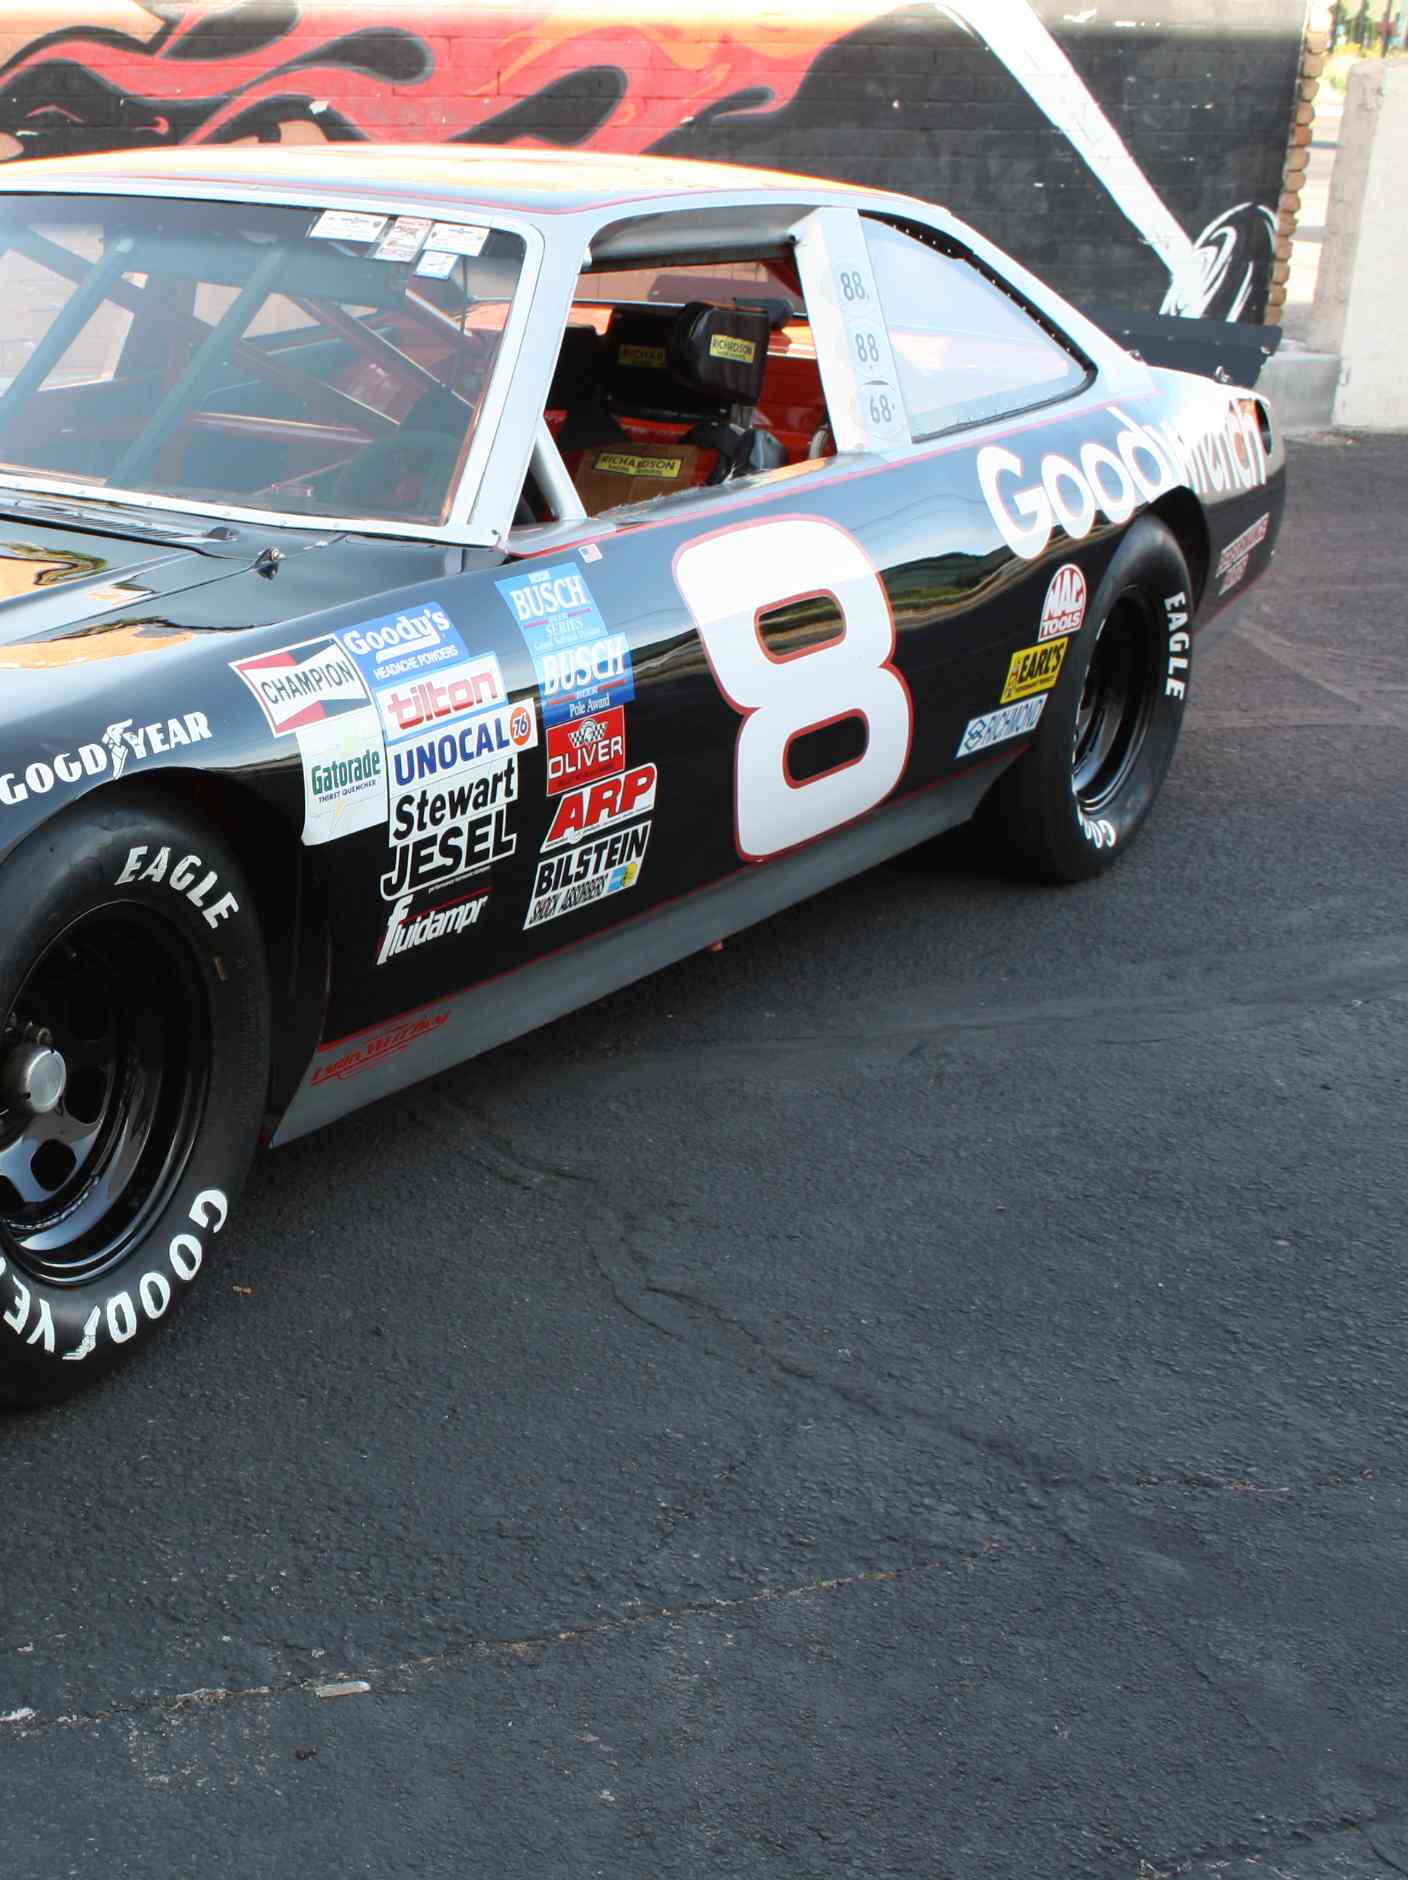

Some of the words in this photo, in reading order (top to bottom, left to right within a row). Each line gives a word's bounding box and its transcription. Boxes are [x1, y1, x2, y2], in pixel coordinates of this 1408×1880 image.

[509, 575, 589, 621] BUSCH
[1041, 612, 1082, 636] TOOLS
[343, 608, 450, 655] Goody's
[373, 656, 419, 680] HEADACHE
[417, 645, 459, 667] POWDERS
[1163, 591, 1191, 701] EAGLE
[260, 659, 355, 705] CHAMPION
[542, 632, 627, 696] BUSCH
[672, 513, 914, 862] 8
[388, 671, 498, 730] tilton
[569, 700, 586, 717] Pole
[587, 693, 610, 712] Award
[311, 749, 381, 795] Gatorade
[393, 717, 510, 786] UNOCAL
[511, 715, 529, 738] 76
[548, 735, 623, 779] OLIVER
[393, 757, 516, 841] Stewart
[546, 766, 656, 844] ARP
[381, 806, 517, 901] JESEL
[533, 824, 650, 899] BILSTEIN
[114, 845, 239, 928] EAGLE
[376, 894, 489, 966] fluidampr
